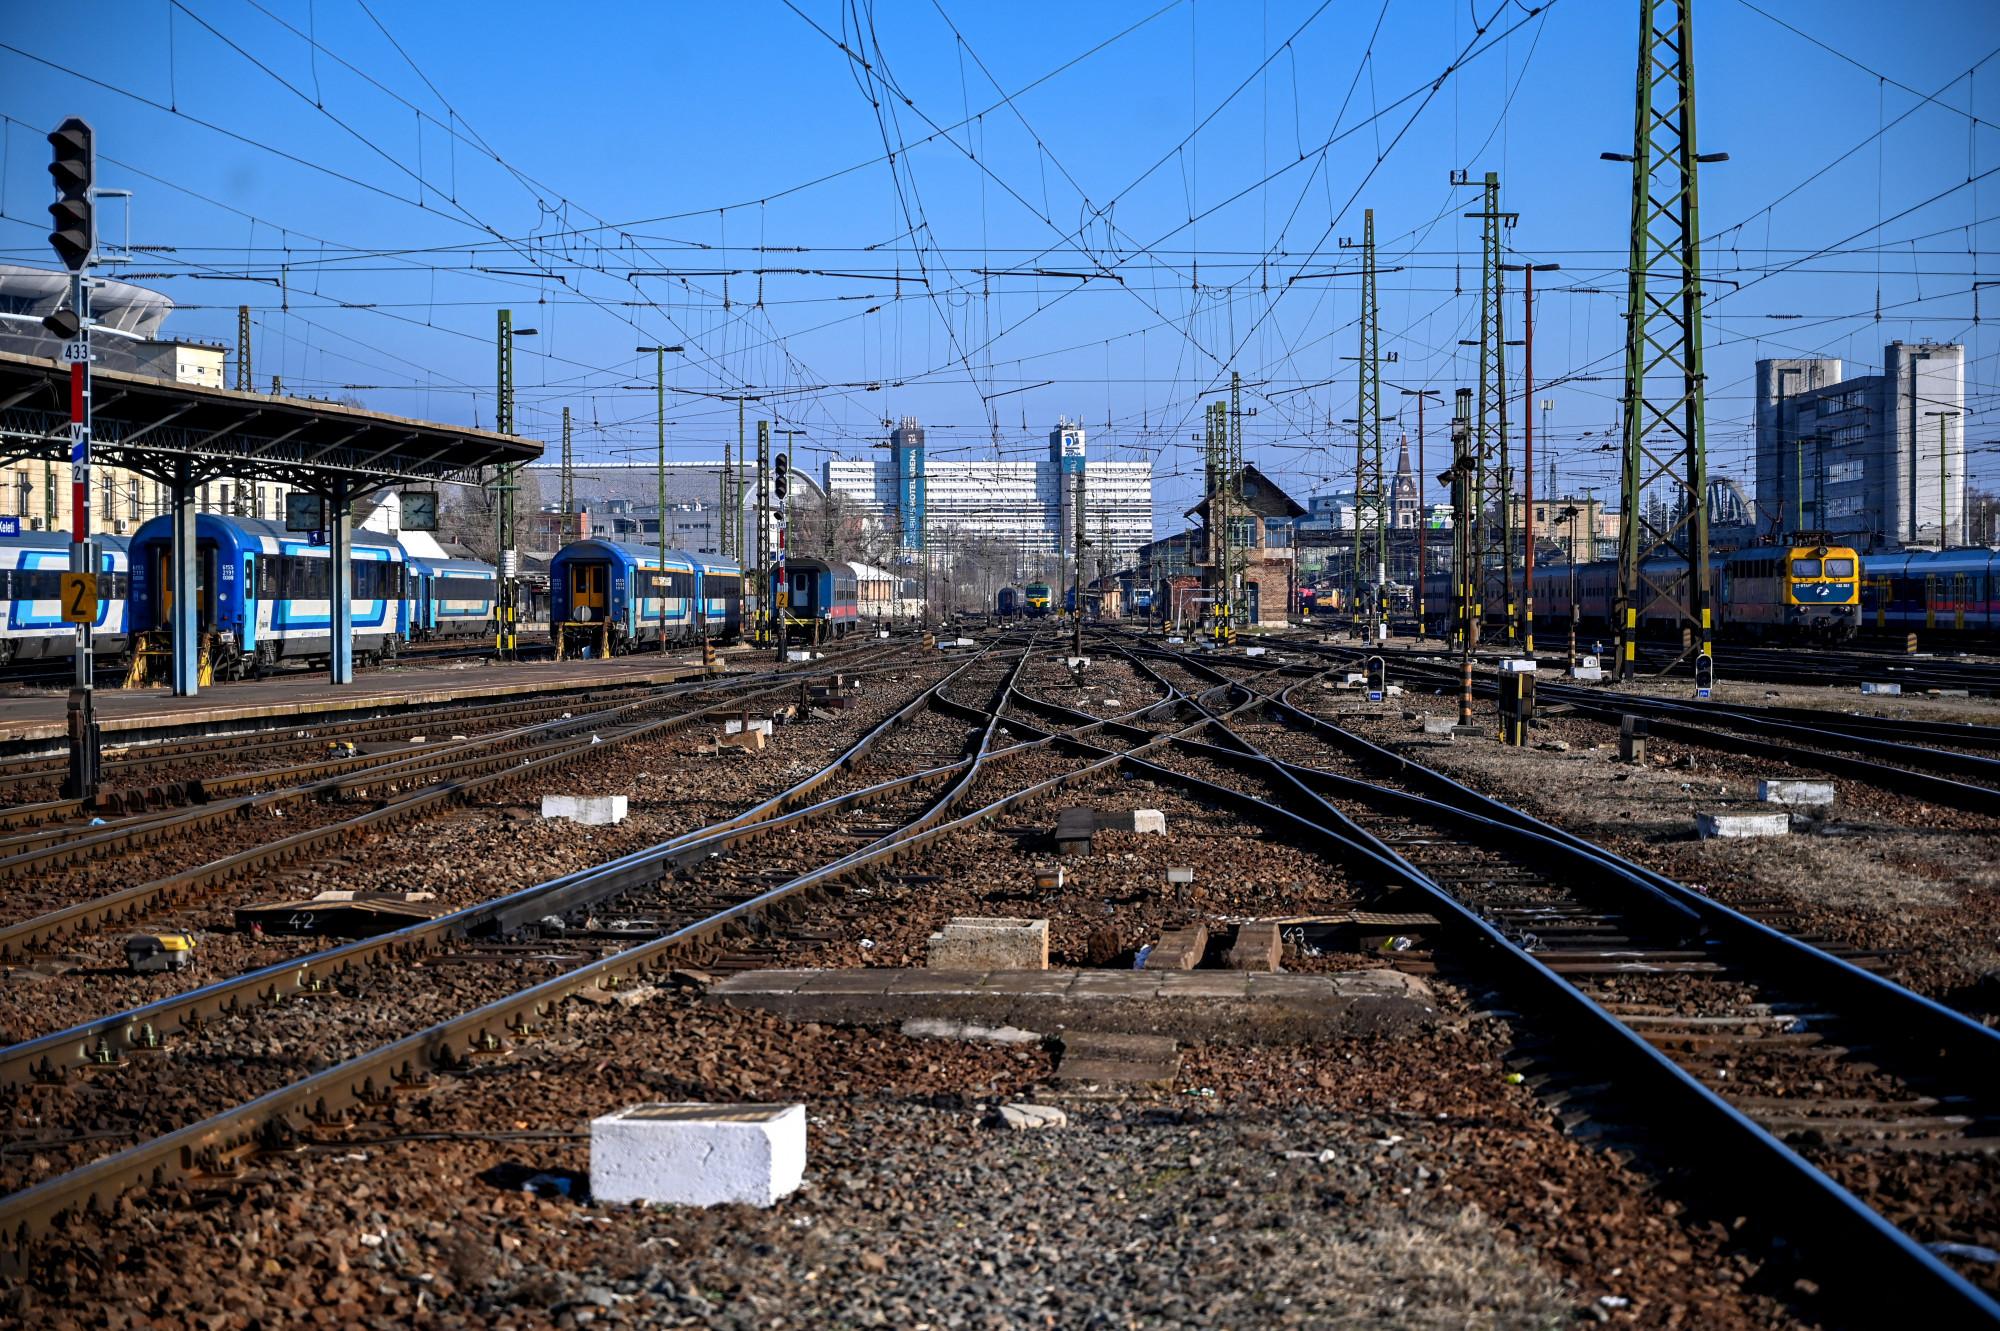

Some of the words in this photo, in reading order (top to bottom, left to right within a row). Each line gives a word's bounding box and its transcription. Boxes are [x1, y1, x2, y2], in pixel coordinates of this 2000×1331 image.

[65, 344, 88, 360] 433
[73, 424, 82, 440] V
[74, 465, 81, 480] 2
[313, 533, 318, 541] 1
[71, 579, 86, 615] 2
[778, 593, 785, 605] 2
[289, 911, 315, 930] 42
